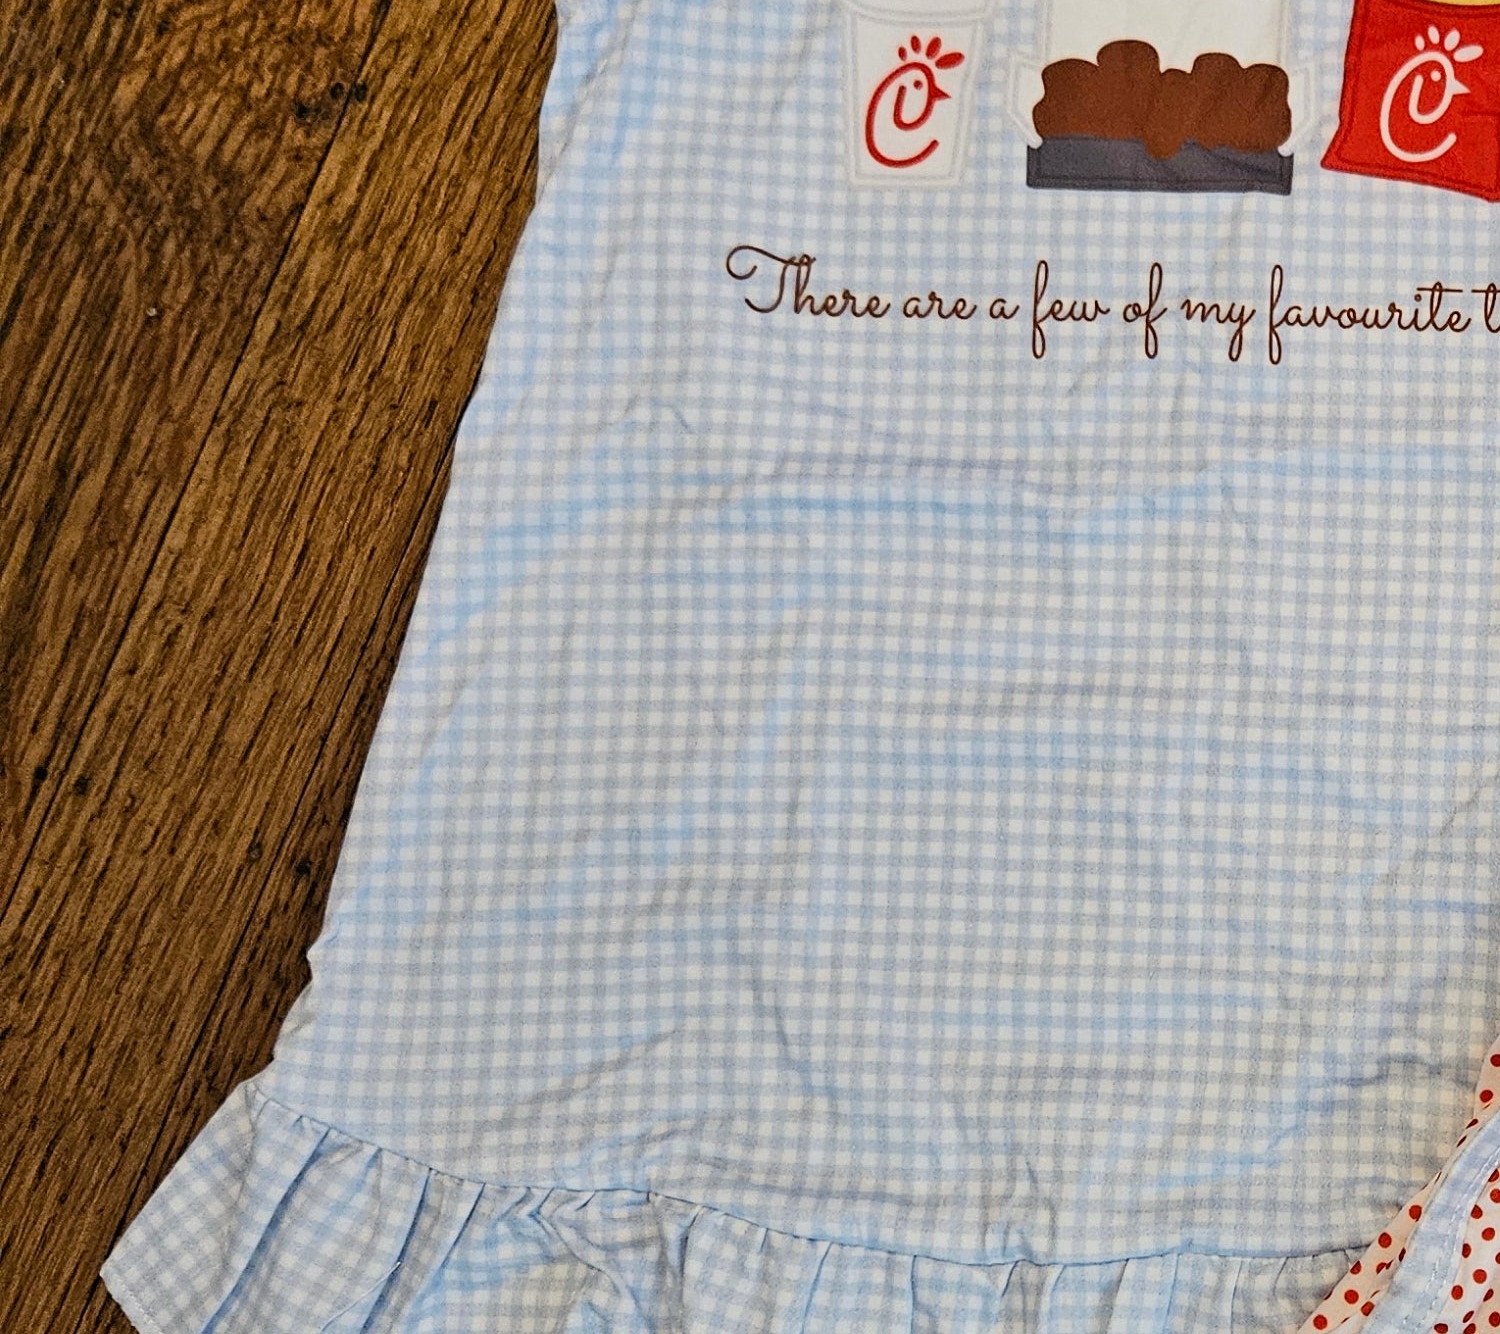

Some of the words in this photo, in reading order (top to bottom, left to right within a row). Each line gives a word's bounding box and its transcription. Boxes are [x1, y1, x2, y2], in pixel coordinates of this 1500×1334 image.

[725, 245, 891, 319] There
[902, 291, 977, 321] are
[989, 298, 1020, 321] a
[1031, 260, 1110, 359] few
[1123, 262, 1168, 359] of
[1181, 298, 1257, 362] my
[1268, 264, 1472, 365] favourite
